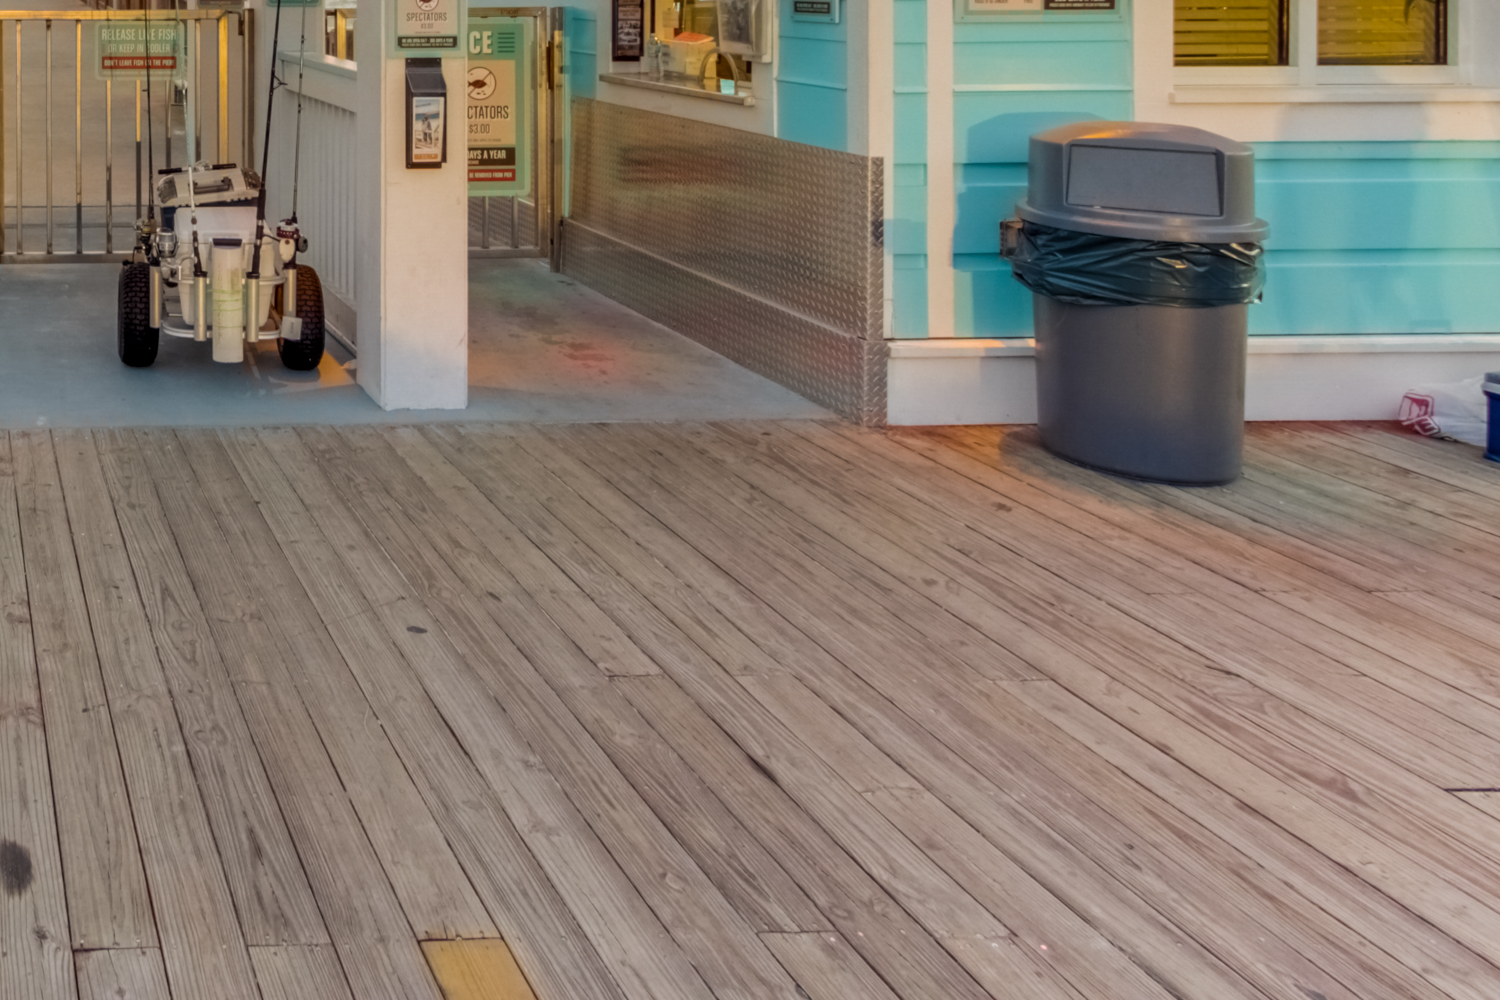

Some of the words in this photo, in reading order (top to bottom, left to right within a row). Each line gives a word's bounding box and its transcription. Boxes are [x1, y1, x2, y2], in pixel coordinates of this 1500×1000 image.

[407, 12, 447, 22] SPECTATORS
[102, 29, 135, 40] RELEASE
[159, 29, 176, 40] FISH
[108, 44, 116, 53] OR
[120, 44, 134, 53] KEEP
[137, 44, 144, 53] IN
[148, 44, 170, 53] OOLER
[468, 105, 509, 120] CTATORS
[469, 124, 490, 134] $3.00
[468, 150, 482, 159] AYS
[483, 150, 488, 159] A
[490, 150, 506, 159] YEAR
